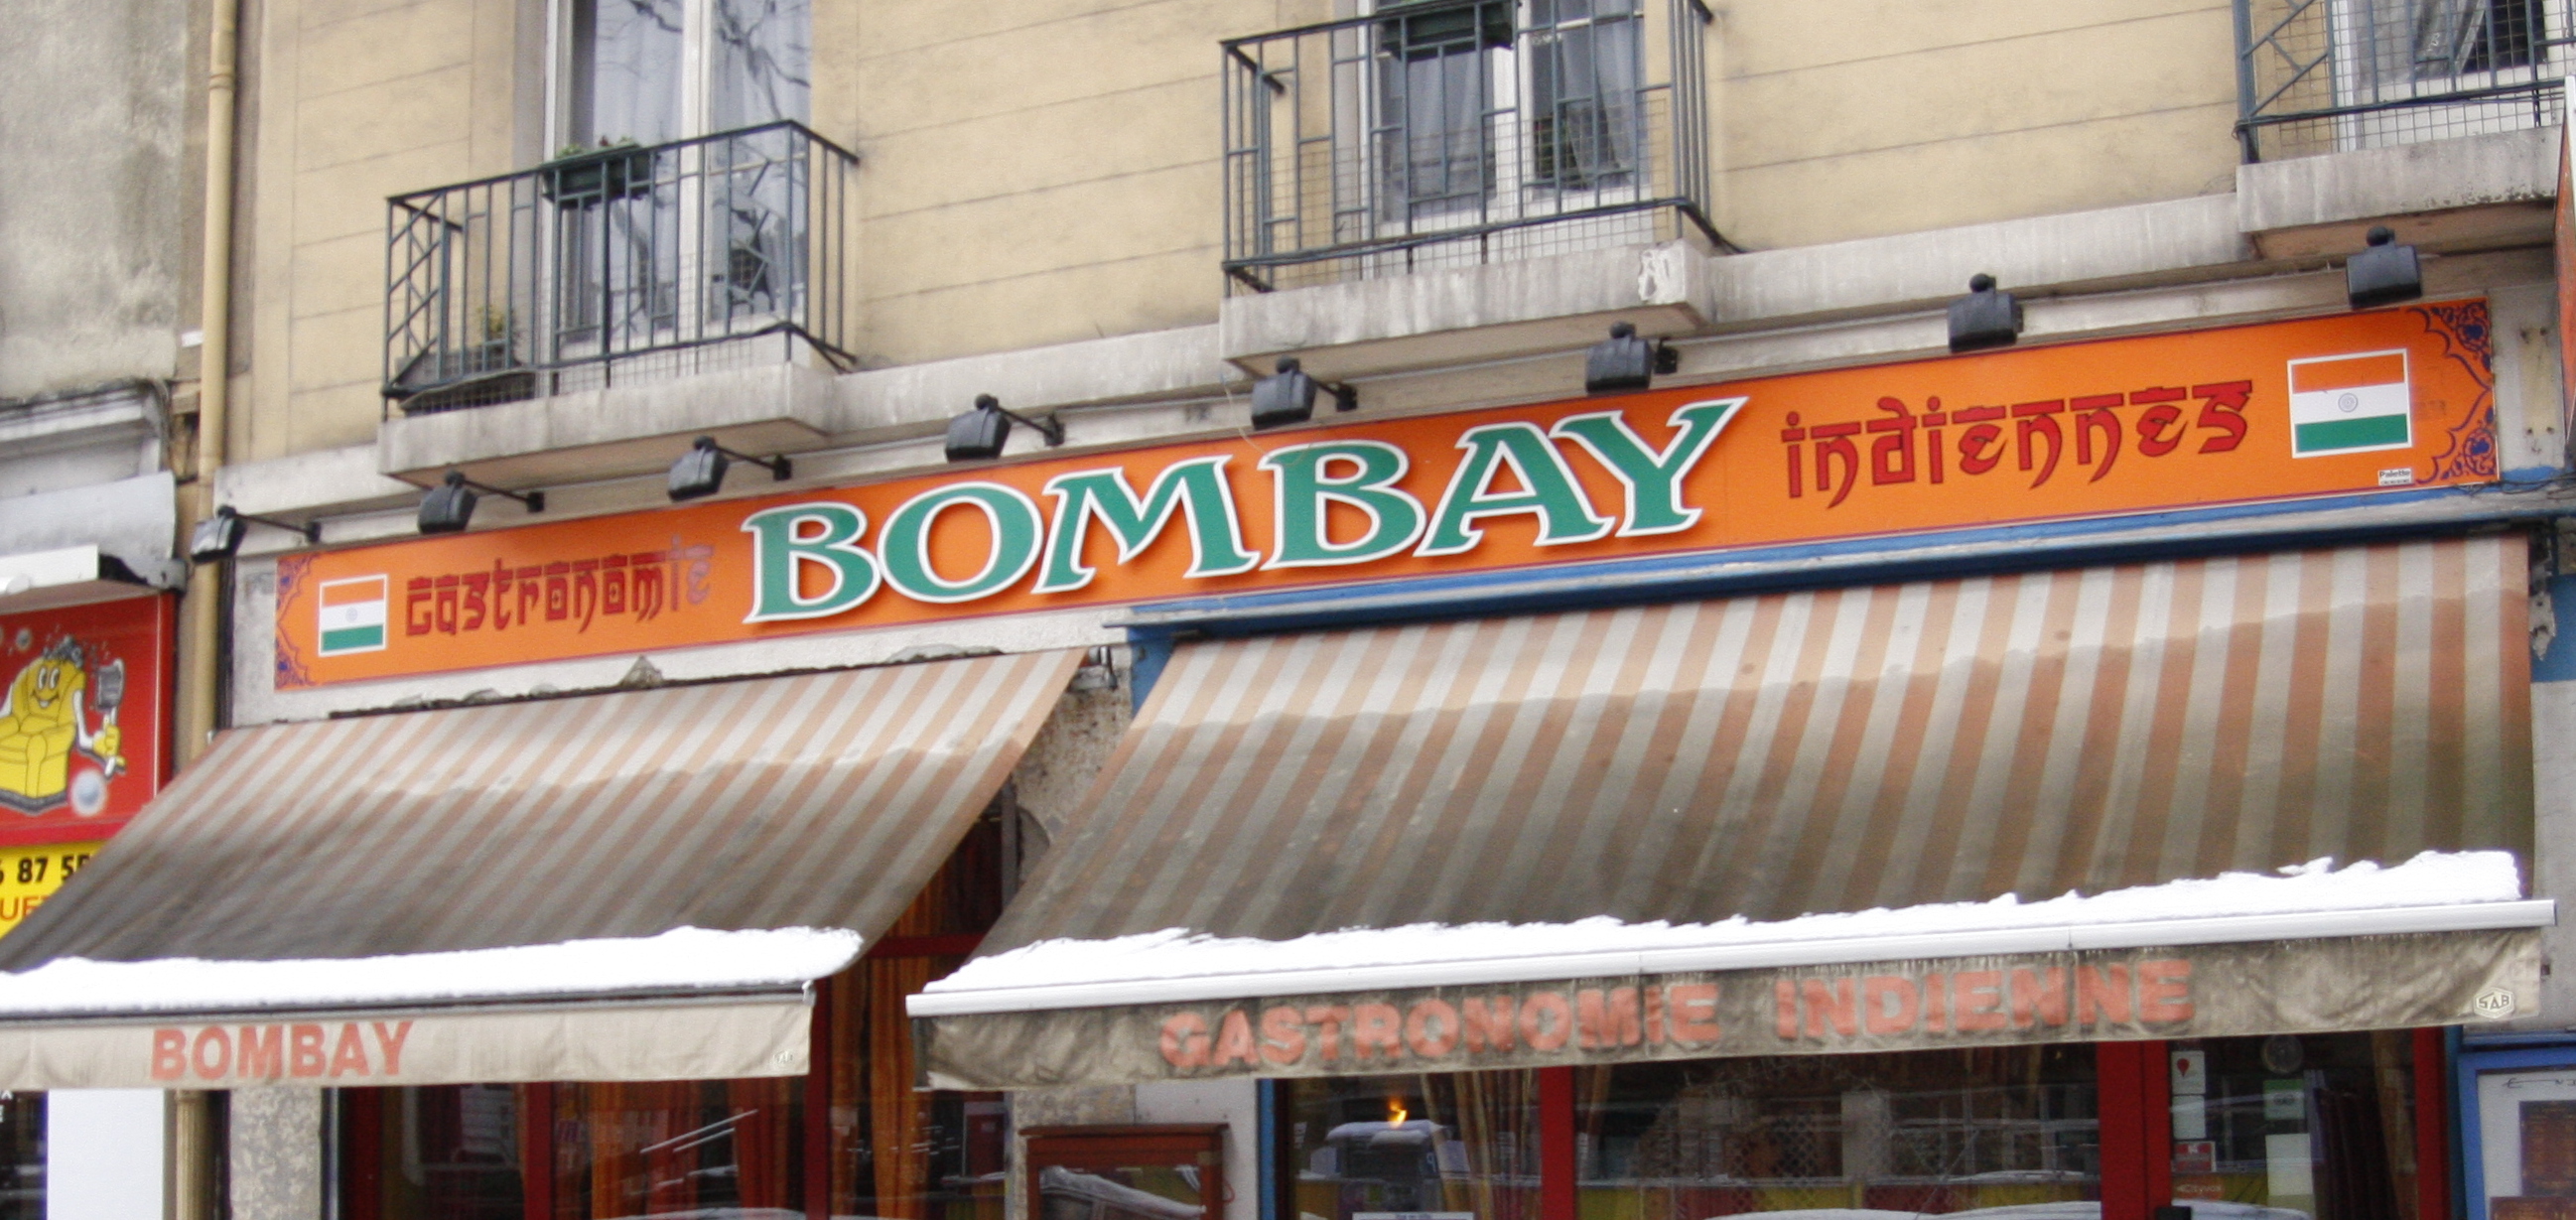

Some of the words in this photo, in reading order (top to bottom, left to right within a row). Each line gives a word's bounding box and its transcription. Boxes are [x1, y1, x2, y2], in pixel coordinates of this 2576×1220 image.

[741, 396, 1749, 624] BOMBAY
[18, 857, 49, 883] 87
[1774, 959, 2196, 1039] INDIENNE
[2479, 993, 2509, 1010] SAB
[151, 1019, 415, 1081] BOMBAY
